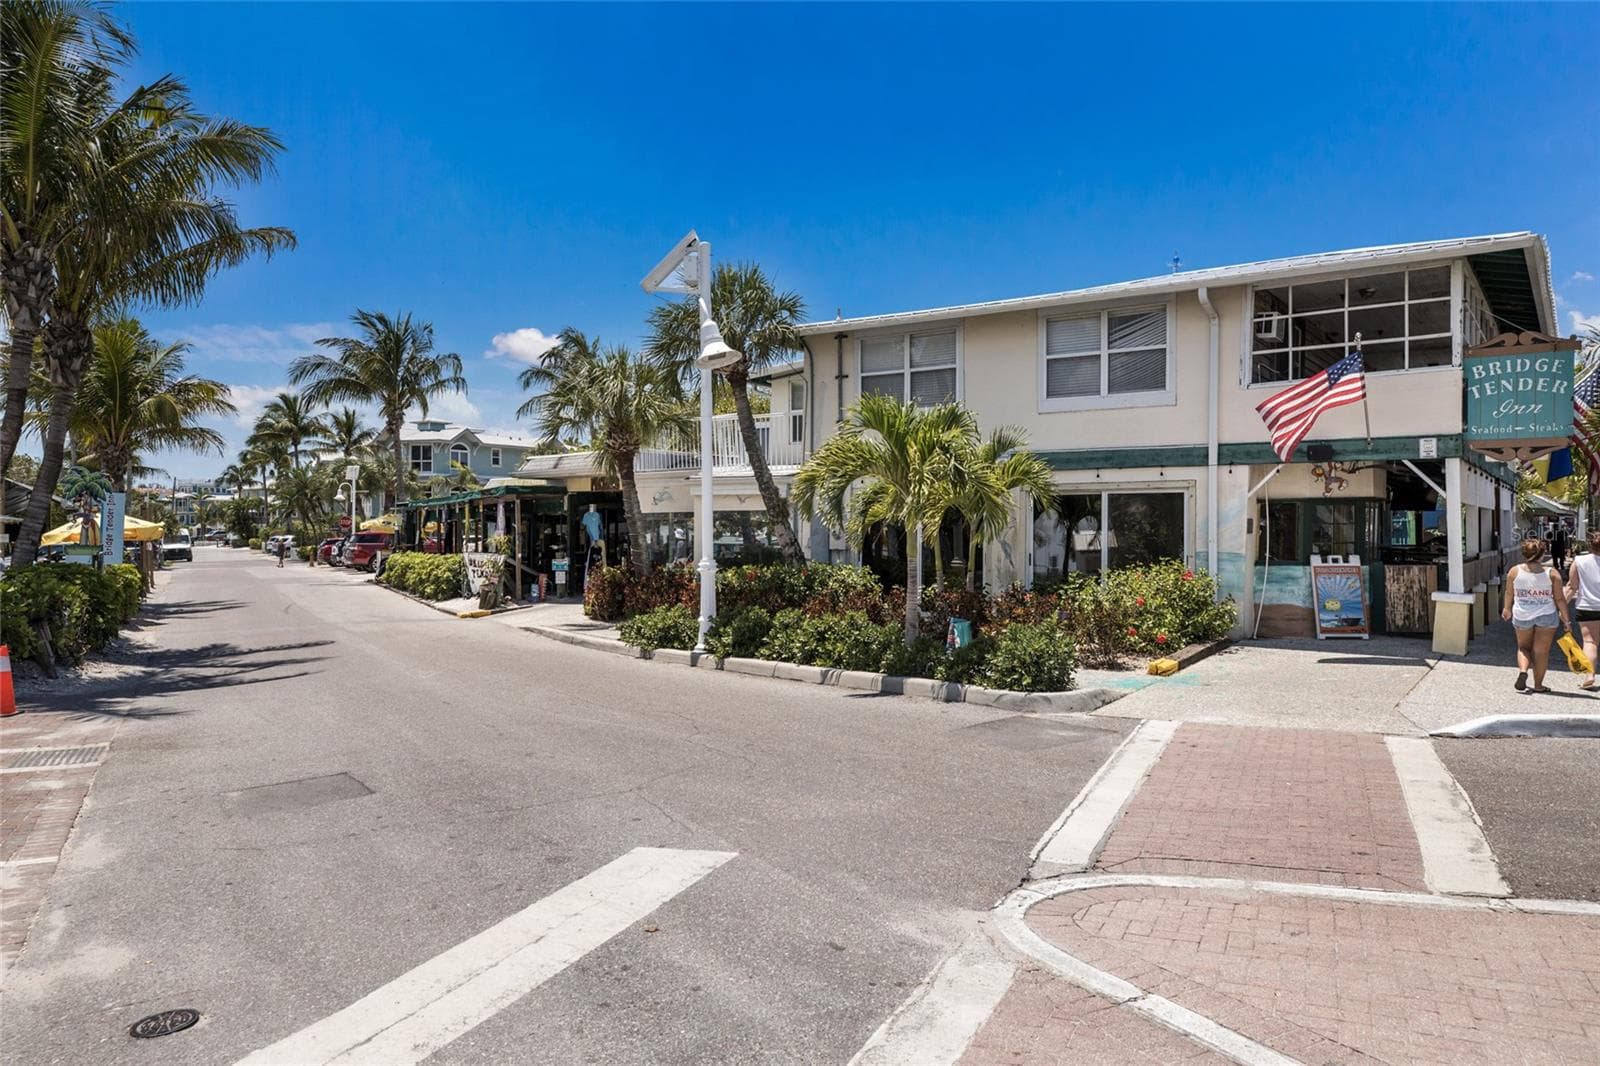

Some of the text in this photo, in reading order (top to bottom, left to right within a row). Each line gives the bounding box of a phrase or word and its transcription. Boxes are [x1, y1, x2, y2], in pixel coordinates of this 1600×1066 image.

[1471, 358, 1566, 379] BRIDGE
[1468, 377, 1568, 399] TENDER
[1492, 398, 1543, 419] Inn
[1471, 424, 1513, 435] Seafood
[1528, 422, 1564, 432] Steaks
[106, 508, 114, 532] Tender
[104, 533, 114, 556] Bridge
